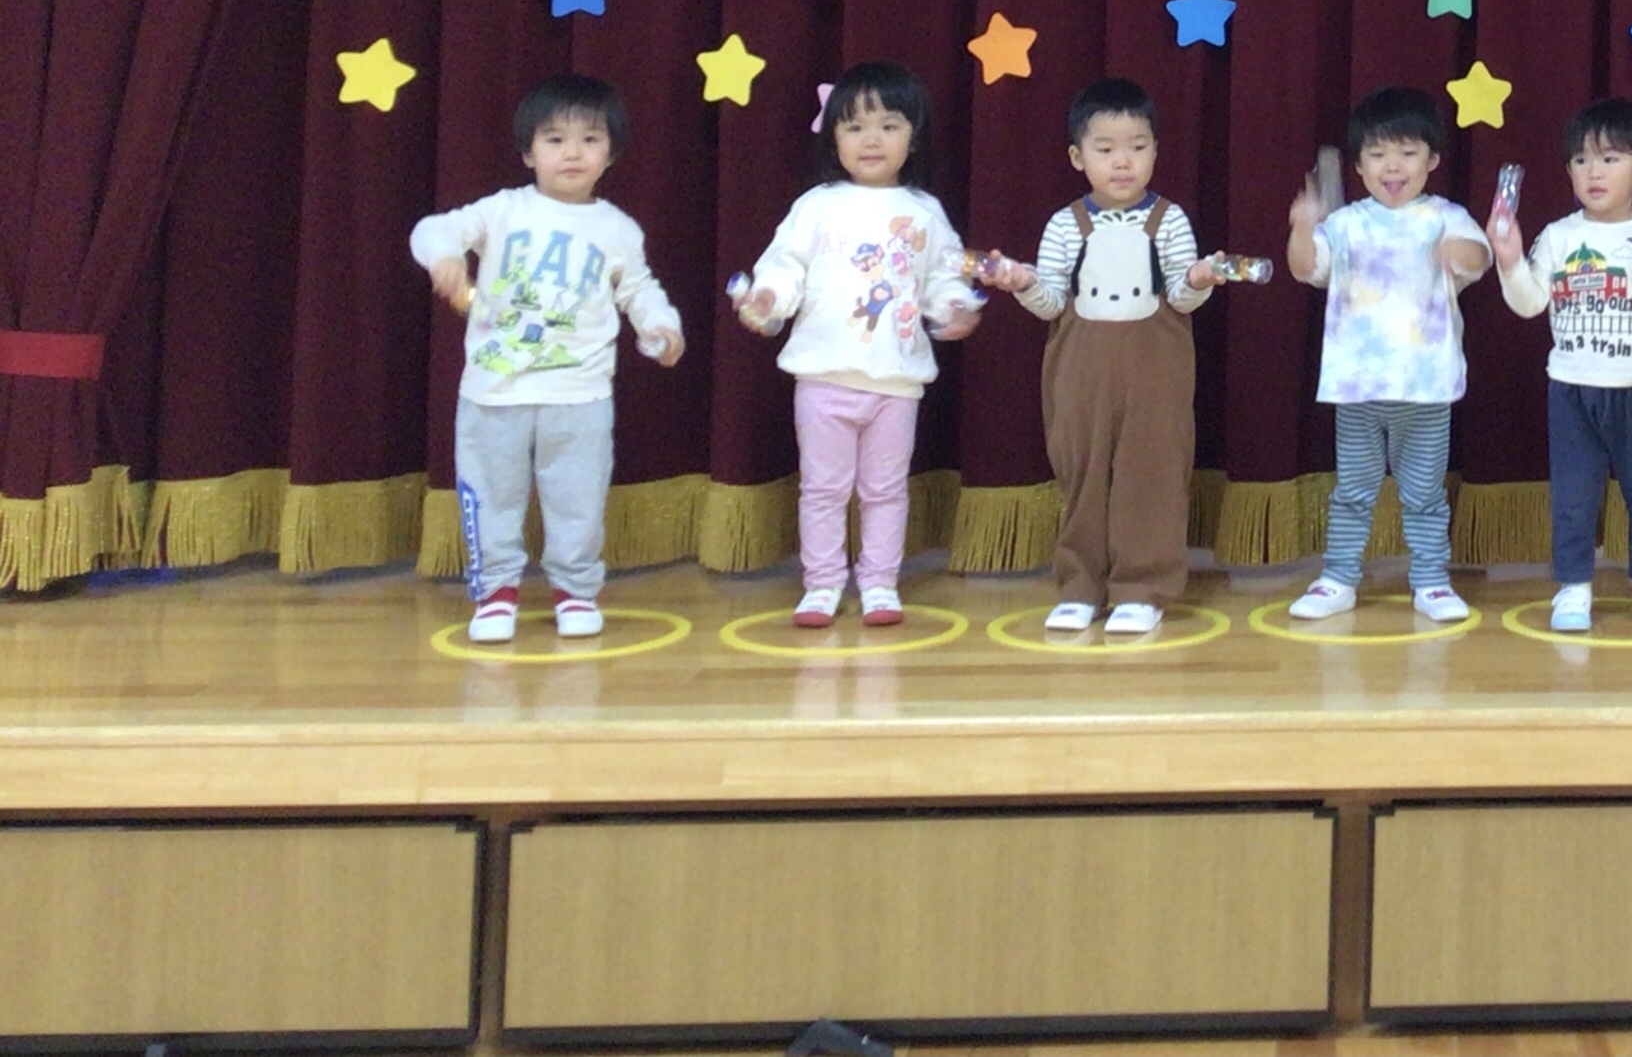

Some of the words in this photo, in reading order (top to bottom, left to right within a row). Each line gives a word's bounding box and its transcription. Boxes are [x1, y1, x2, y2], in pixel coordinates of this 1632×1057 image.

[499, 229, 606, 297] GAP
[1586, 294, 1605, 314] go
[1576, 334, 1584, 349] a
